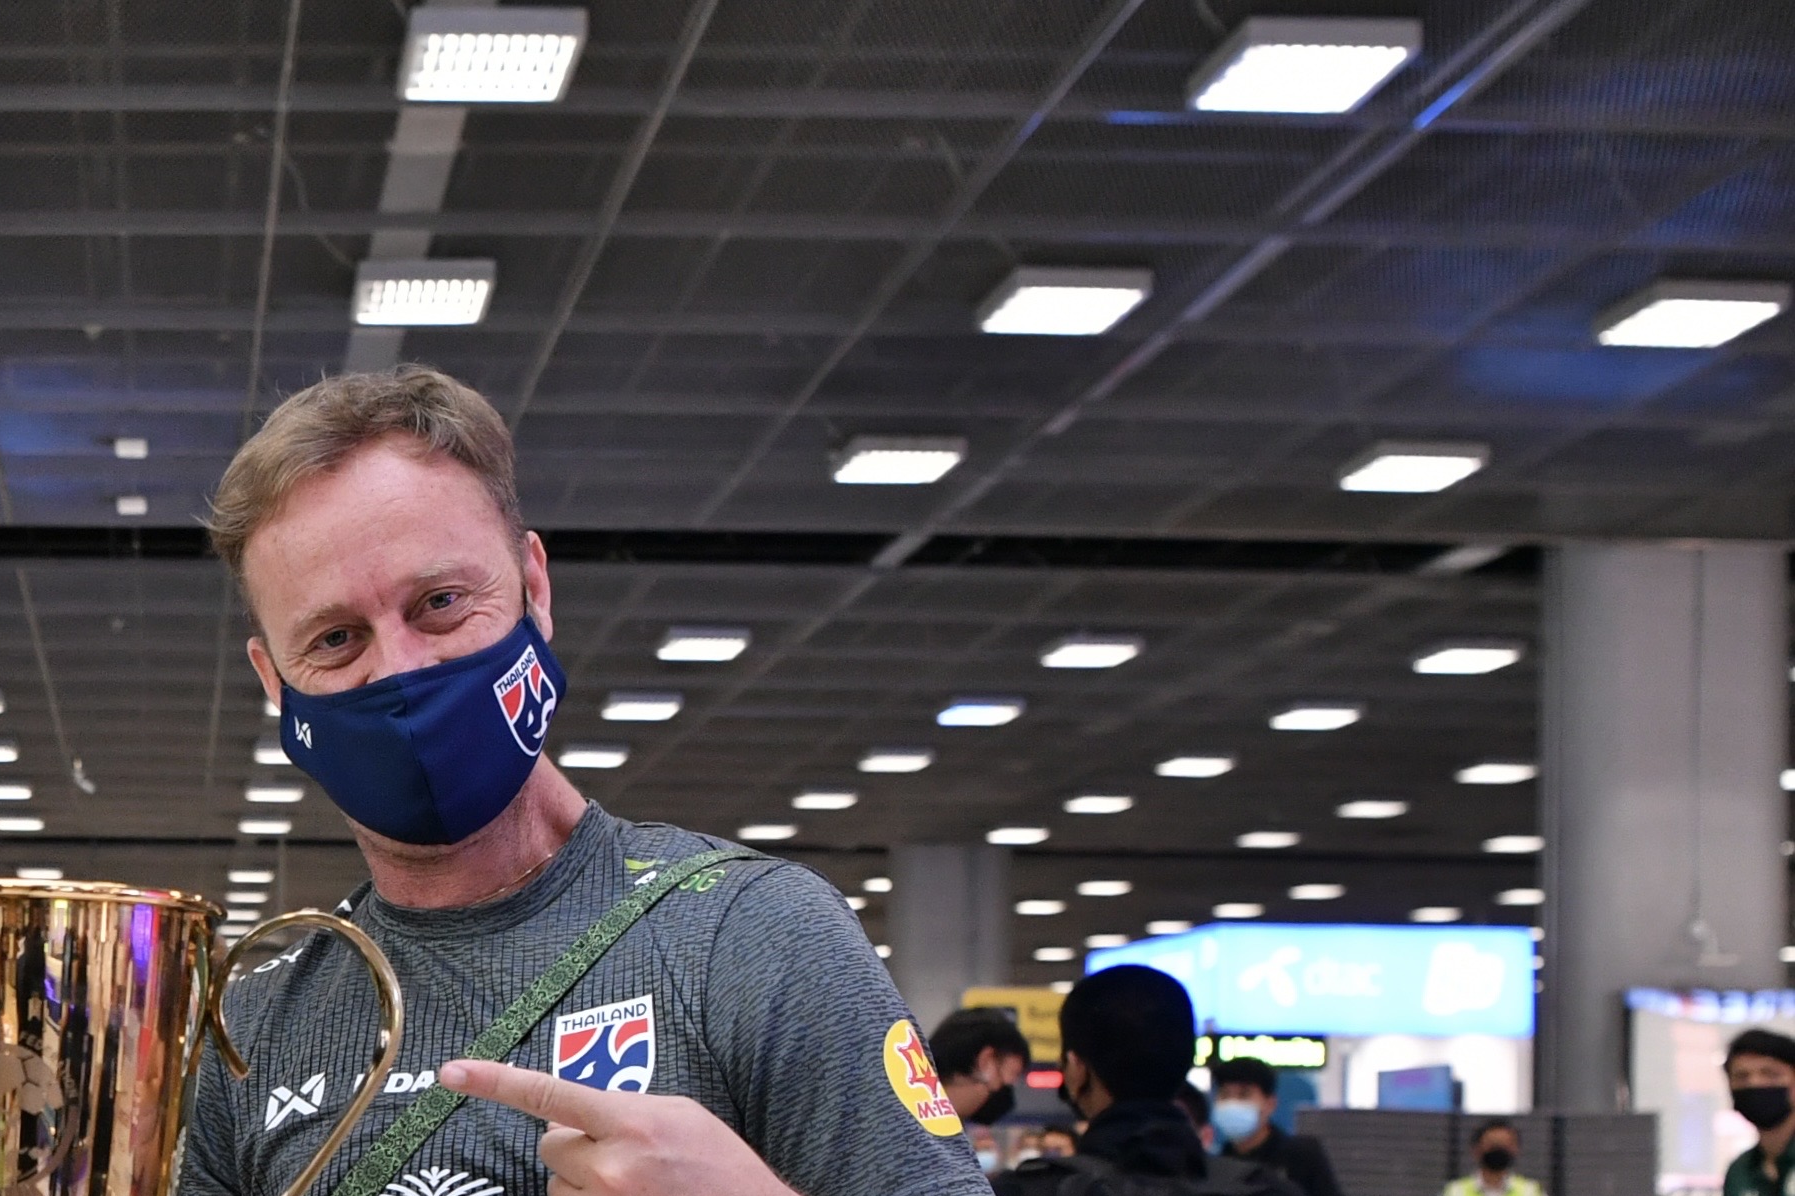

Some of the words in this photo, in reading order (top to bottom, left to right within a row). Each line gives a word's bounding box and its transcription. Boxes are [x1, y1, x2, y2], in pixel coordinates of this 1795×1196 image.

[497, 651, 536, 694] THAILAND
[562, 1003, 648, 1031] THAILAND
[917, 1099, 957, 1119] M-15
